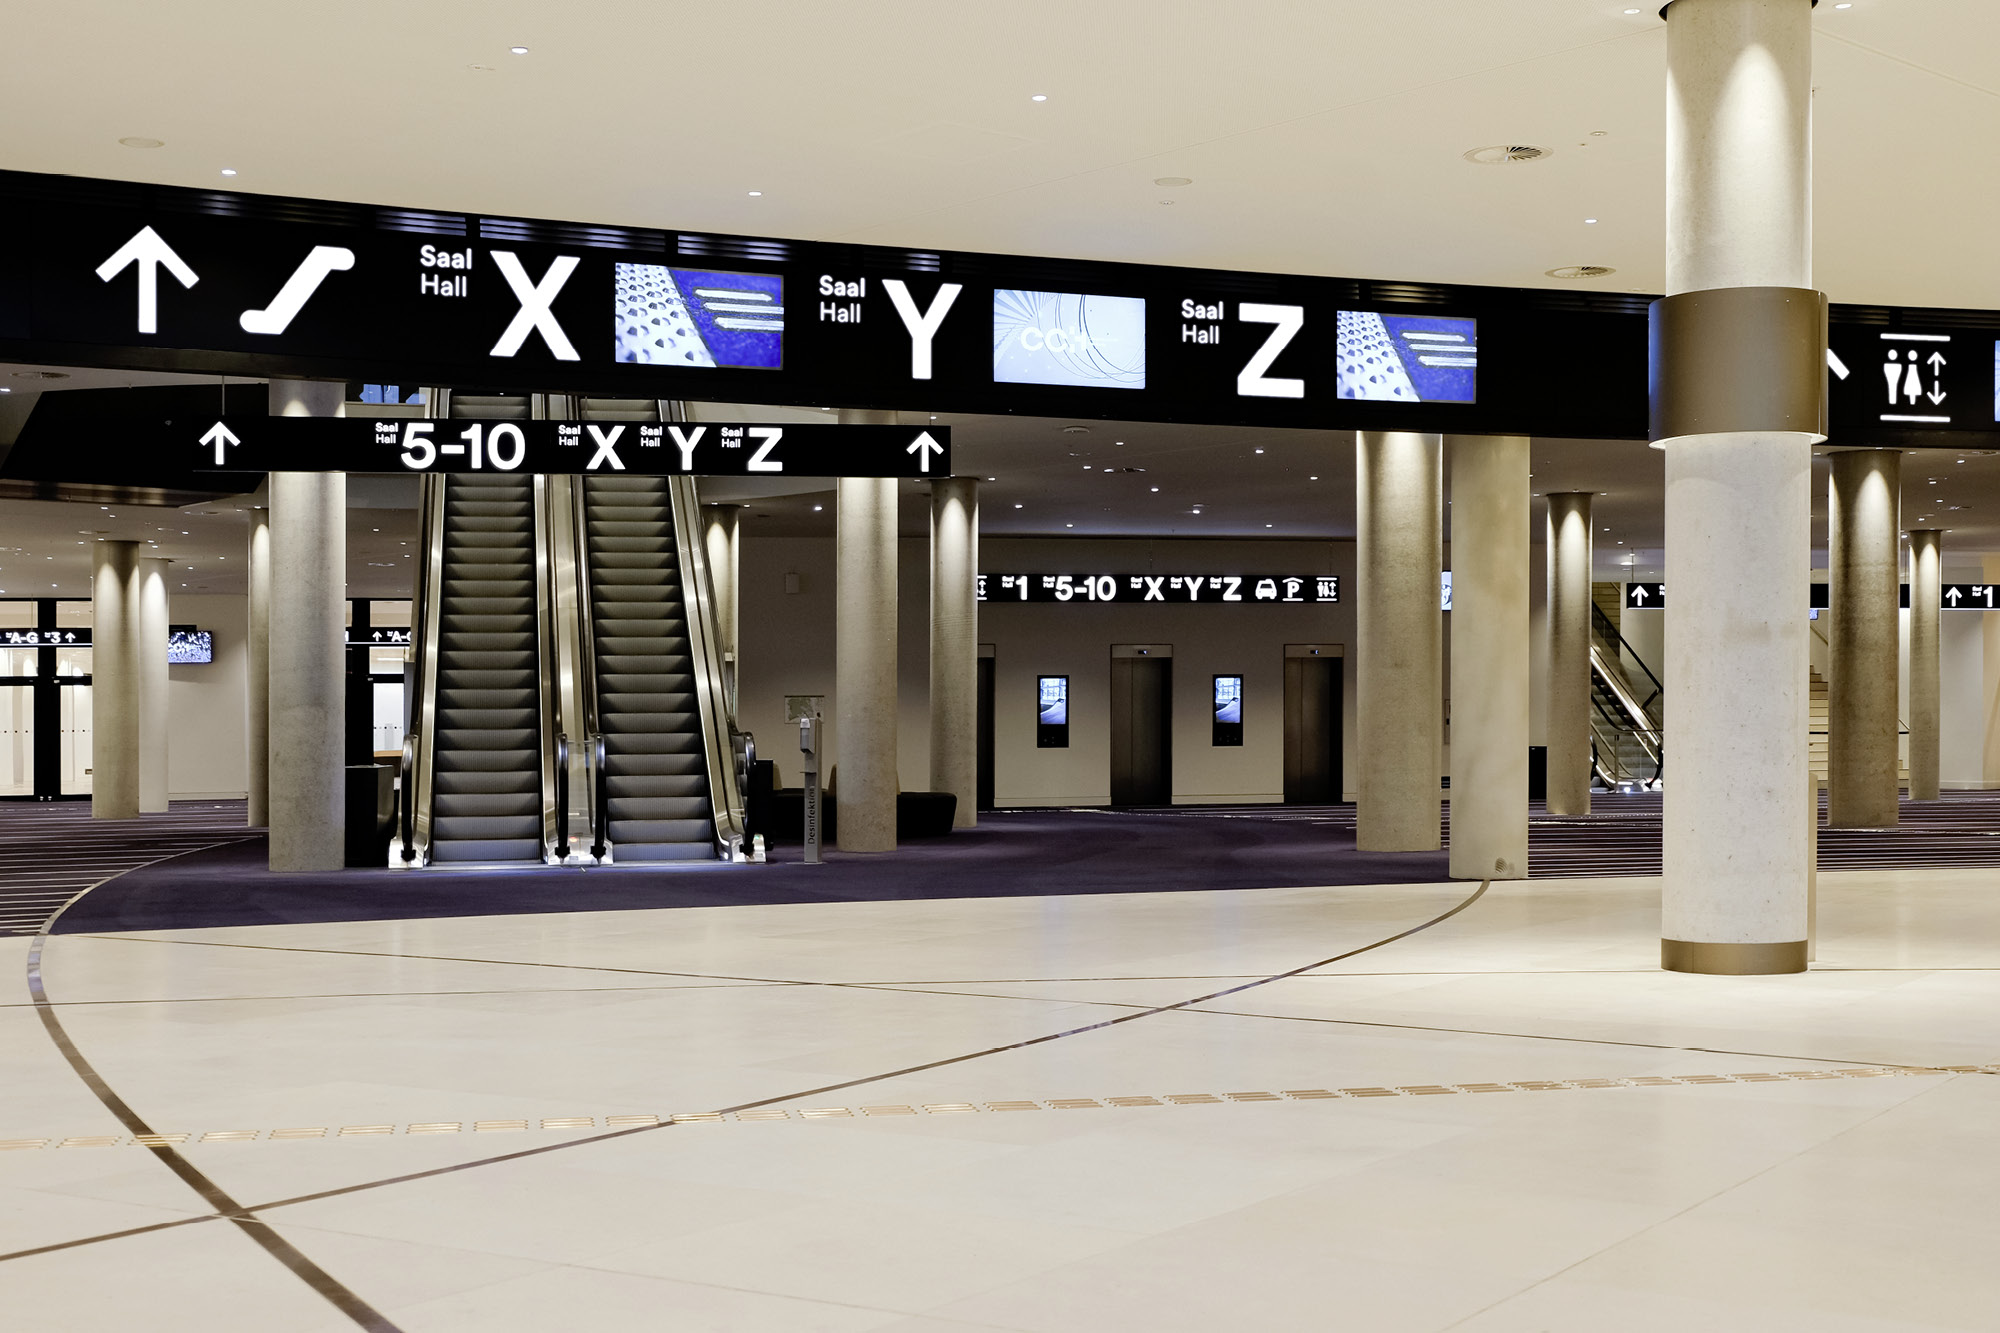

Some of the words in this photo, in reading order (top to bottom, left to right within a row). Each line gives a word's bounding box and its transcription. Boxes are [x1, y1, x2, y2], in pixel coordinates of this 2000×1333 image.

[419, 244, 474, 270] Saal
[420, 272, 471, 298] Hall
[818, 274, 867, 299] Saal
[490, 250, 582, 363] X
[819, 300, 862, 325] Hall
[1181, 297, 1225, 320] Saal
[882, 279, 964, 380] Y
[1181, 322, 1221, 346] Hall
[1236, 301, 1305, 398] Z
[375, 422, 399, 433] Saal
[375, 433, 397, 444] Hall
[558, 424, 581, 435] Saal
[640, 426, 663, 437] Saal
[721, 427, 744, 438] Saal
[400, 422, 526, 471] 5-10
[558, 436, 579, 447] Hall
[586, 424, 626, 470] X
[640, 437, 661, 448] Hall
[667, 426, 707, 471] Y
[721, 438, 741, 448] Hall
[747, 427, 783, 472] Z
[1015, 575, 1028, 601] 1
[1054, 575, 1117, 602] 5-10
[1144, 576, 1165, 601] X
[1184, 576, 1205, 601] Y
[1223, 576, 1242, 601] Z
[1983, 585, 1994, 608] 1
[10, 631, 39, 644] A-G
[50, 631, 61, 644] 3
[808, 785, 816, 845] Desinfektion
